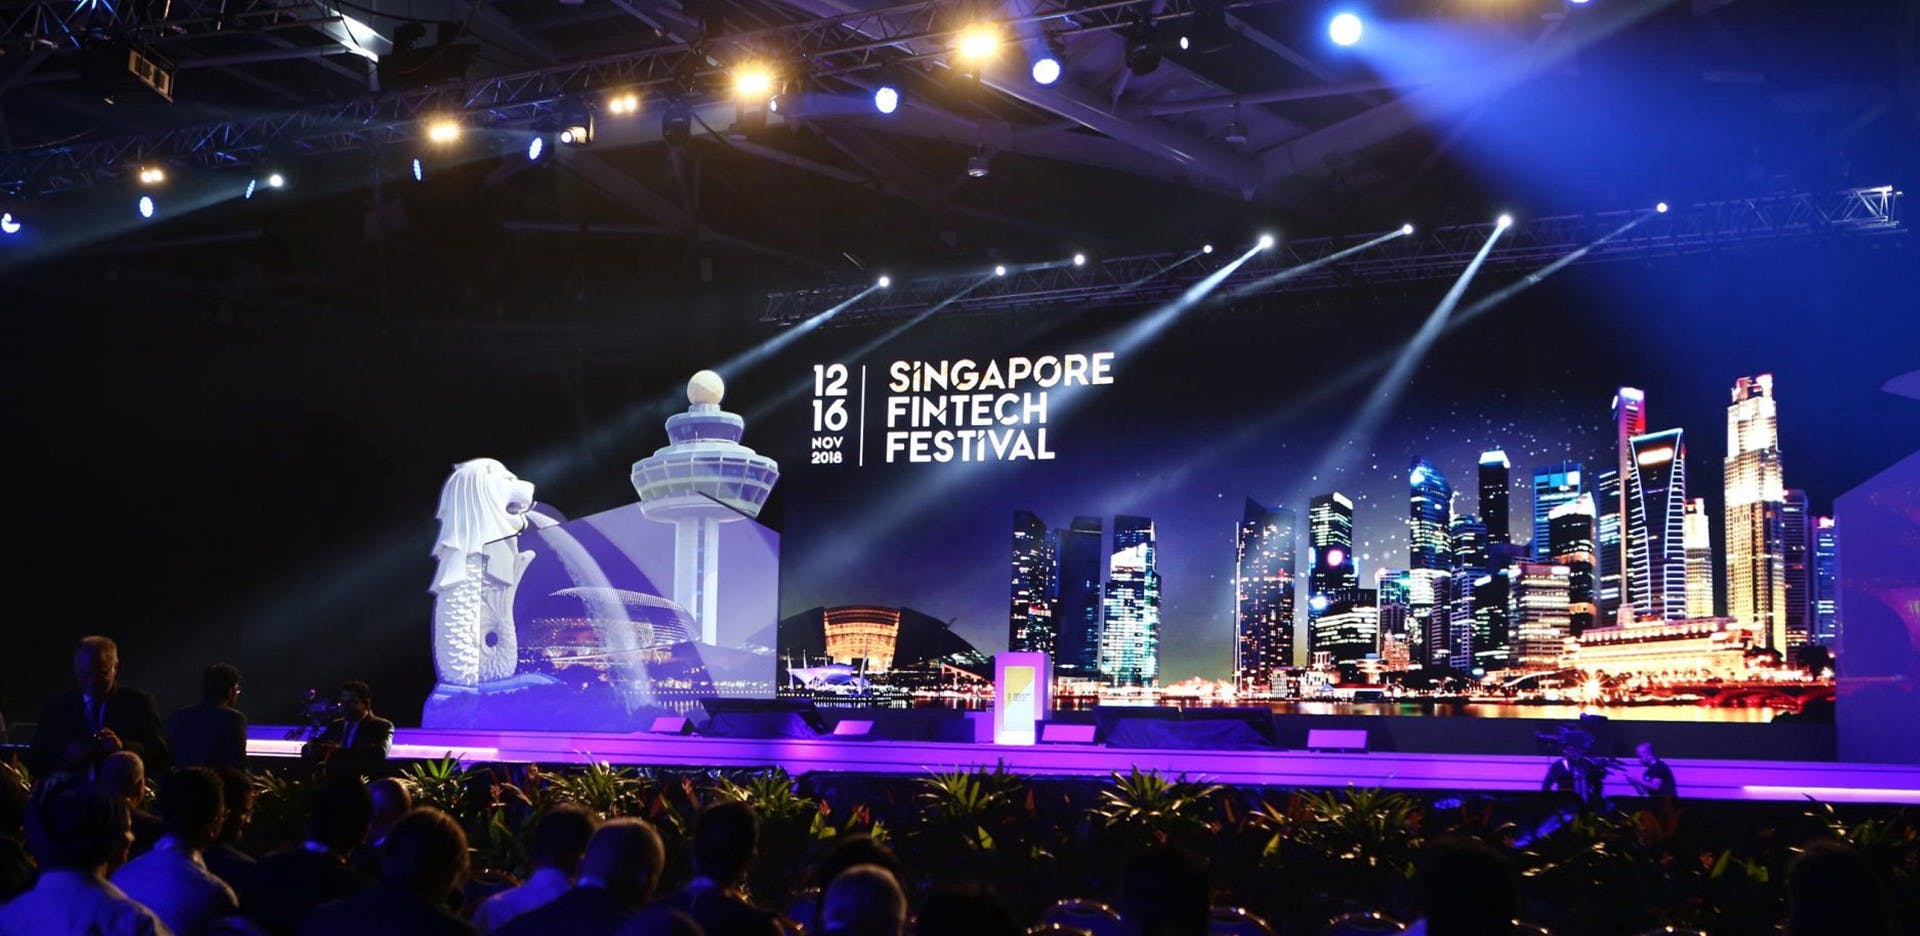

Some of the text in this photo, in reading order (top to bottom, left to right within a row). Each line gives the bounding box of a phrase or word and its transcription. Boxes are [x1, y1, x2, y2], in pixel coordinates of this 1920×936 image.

[813, 363, 849, 397] 12
[888, 352, 1115, 393] SINGAPORE
[812, 398, 849, 432] 16
[887, 391, 1048, 428] FINTECH
[810, 451, 843, 464] 2018
[811, 436, 844, 449] NOV
[885, 427, 1056, 464] FESTIVAL
